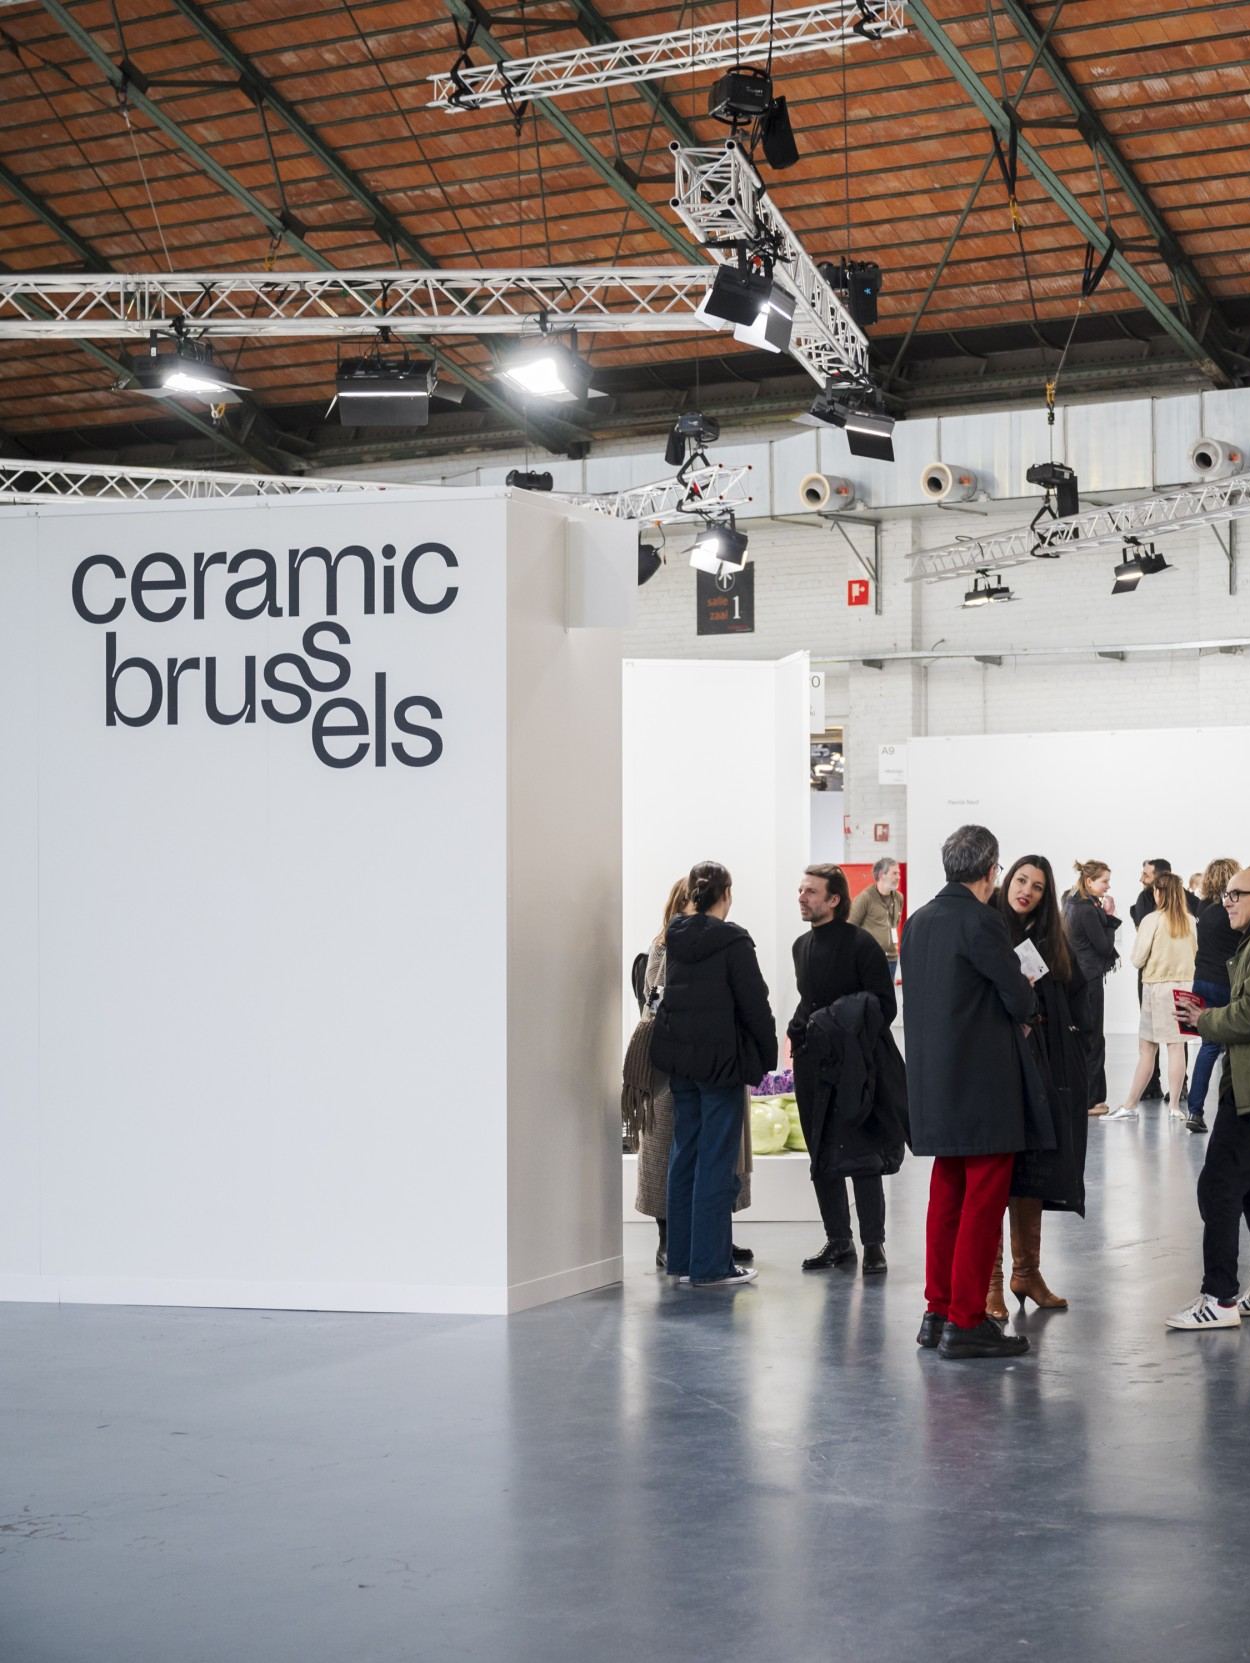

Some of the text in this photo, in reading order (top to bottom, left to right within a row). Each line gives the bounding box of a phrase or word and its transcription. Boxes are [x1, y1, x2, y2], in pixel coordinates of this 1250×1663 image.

[71, 542, 459, 624] ceramic
[732, 595, 741, 620] 1
[105, 620, 444, 769] brussels
[881, 746, 896, 755] A9
